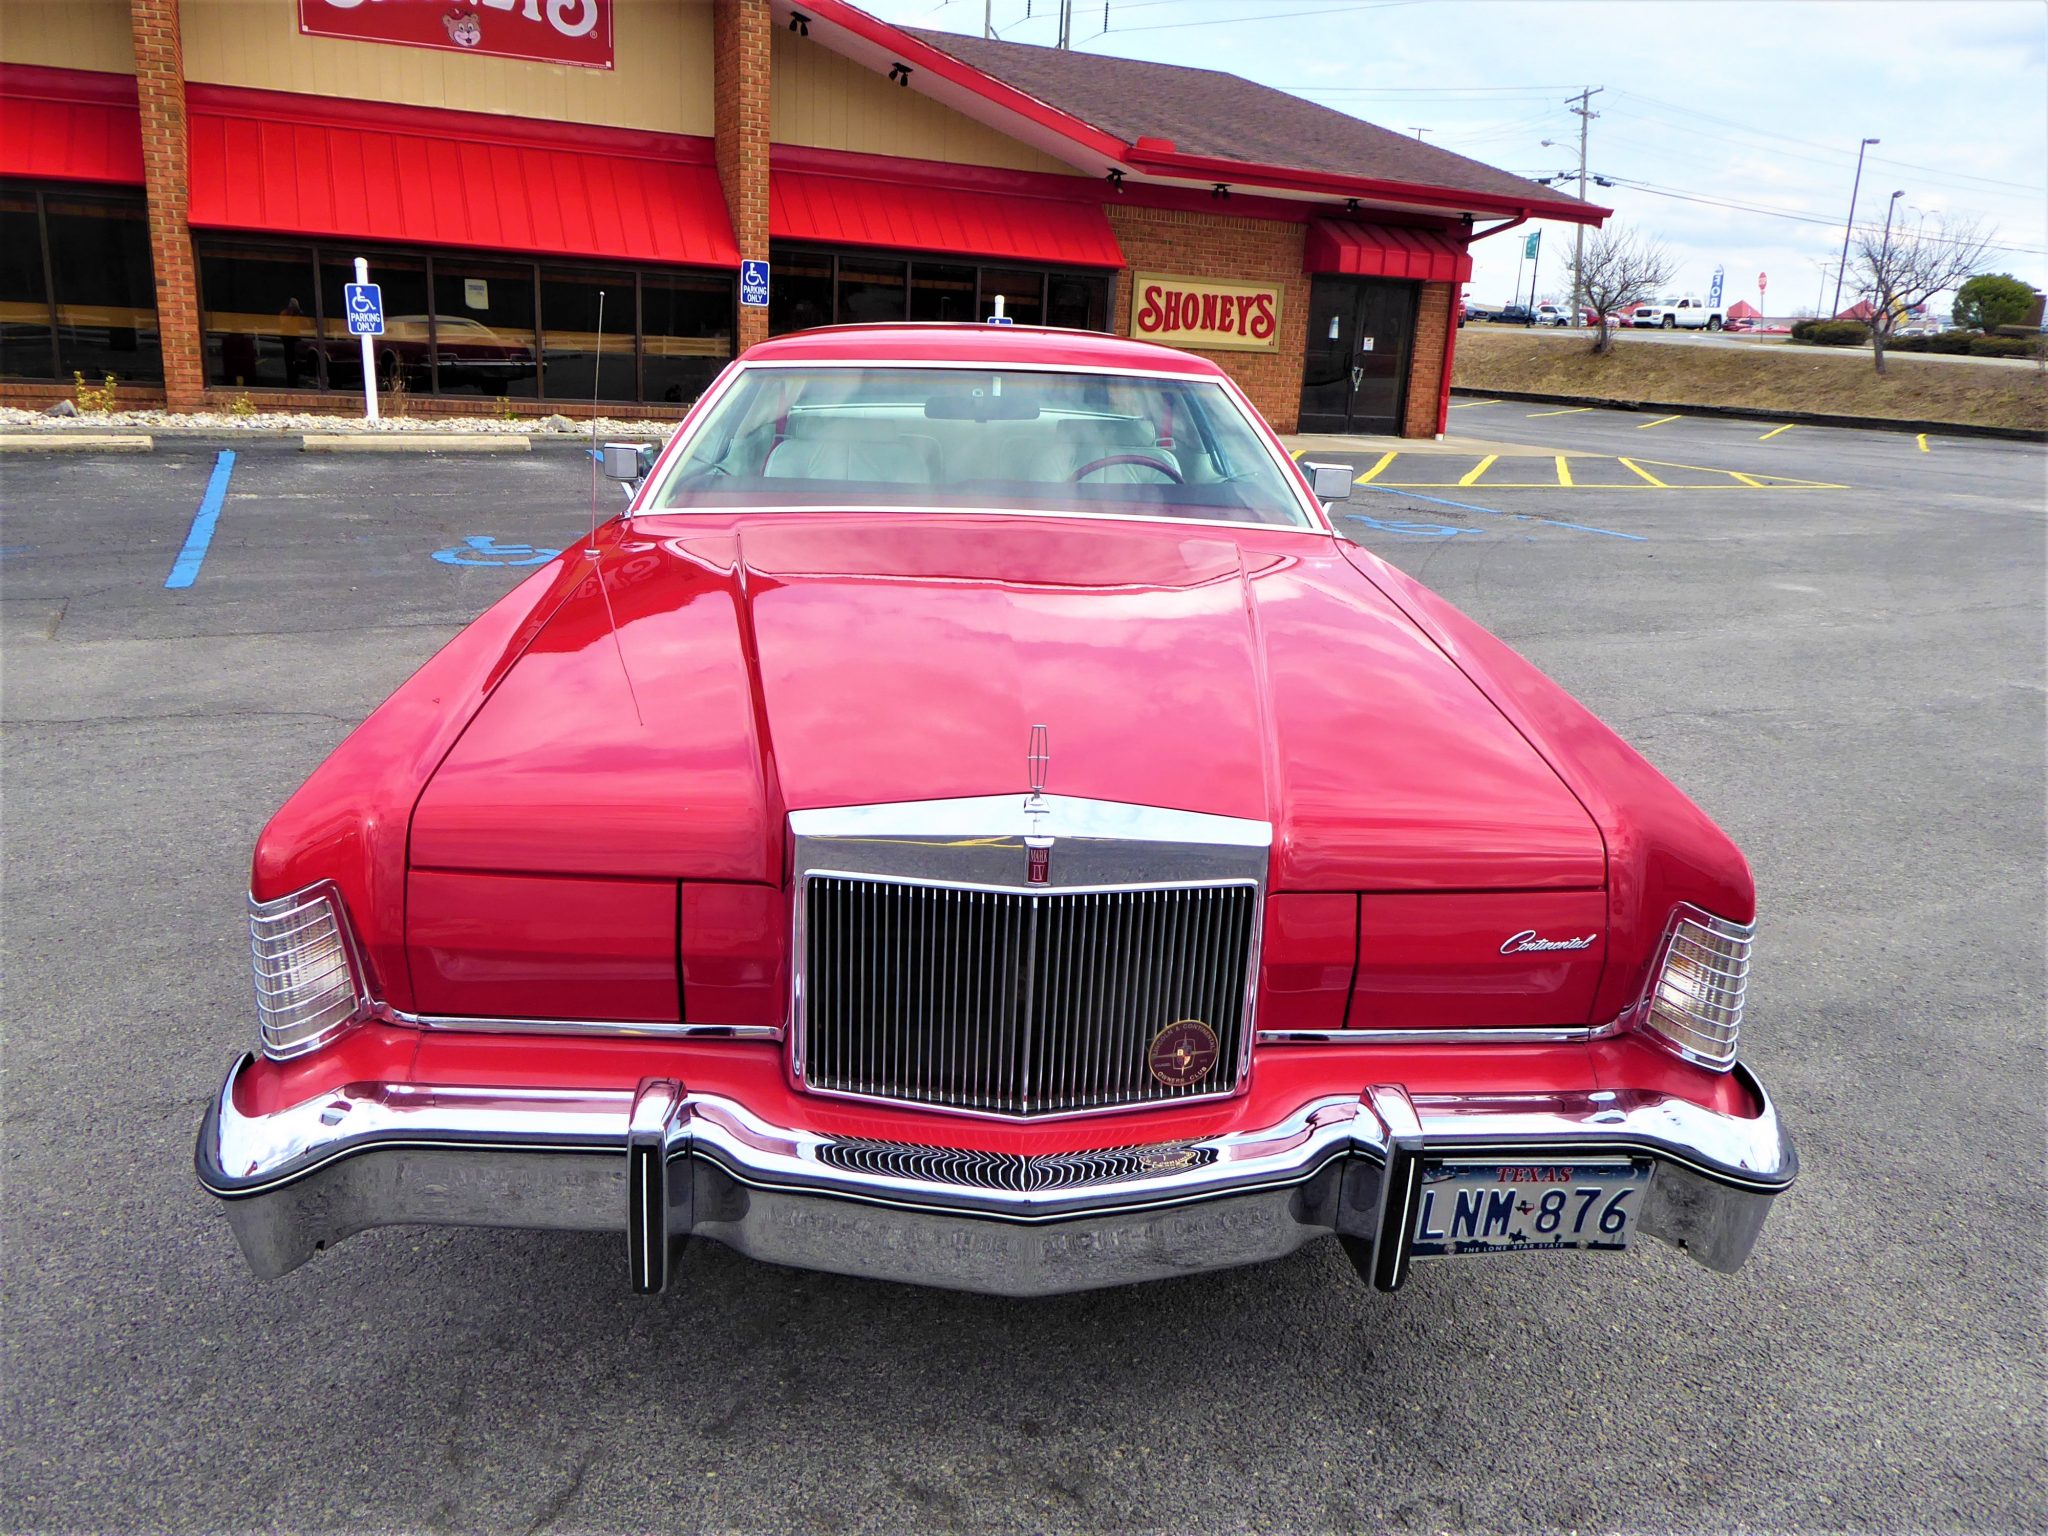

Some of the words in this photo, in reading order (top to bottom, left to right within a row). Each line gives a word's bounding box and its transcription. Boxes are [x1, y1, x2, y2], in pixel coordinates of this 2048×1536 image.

[743, 285, 767, 295] PARKING
[747, 294, 762, 303] ONLY
[350, 312, 380, 322] PARKING
[357, 322, 376, 331] ONLY
[1500, 929, 1597, 954] Continental
[1189, 1066, 1207, 1080] CLUB
[1496, 1167, 1574, 1183] TEXAS
[1418, 1188, 1517, 1240] LNM
[1535, 1187, 1635, 1234] 876
